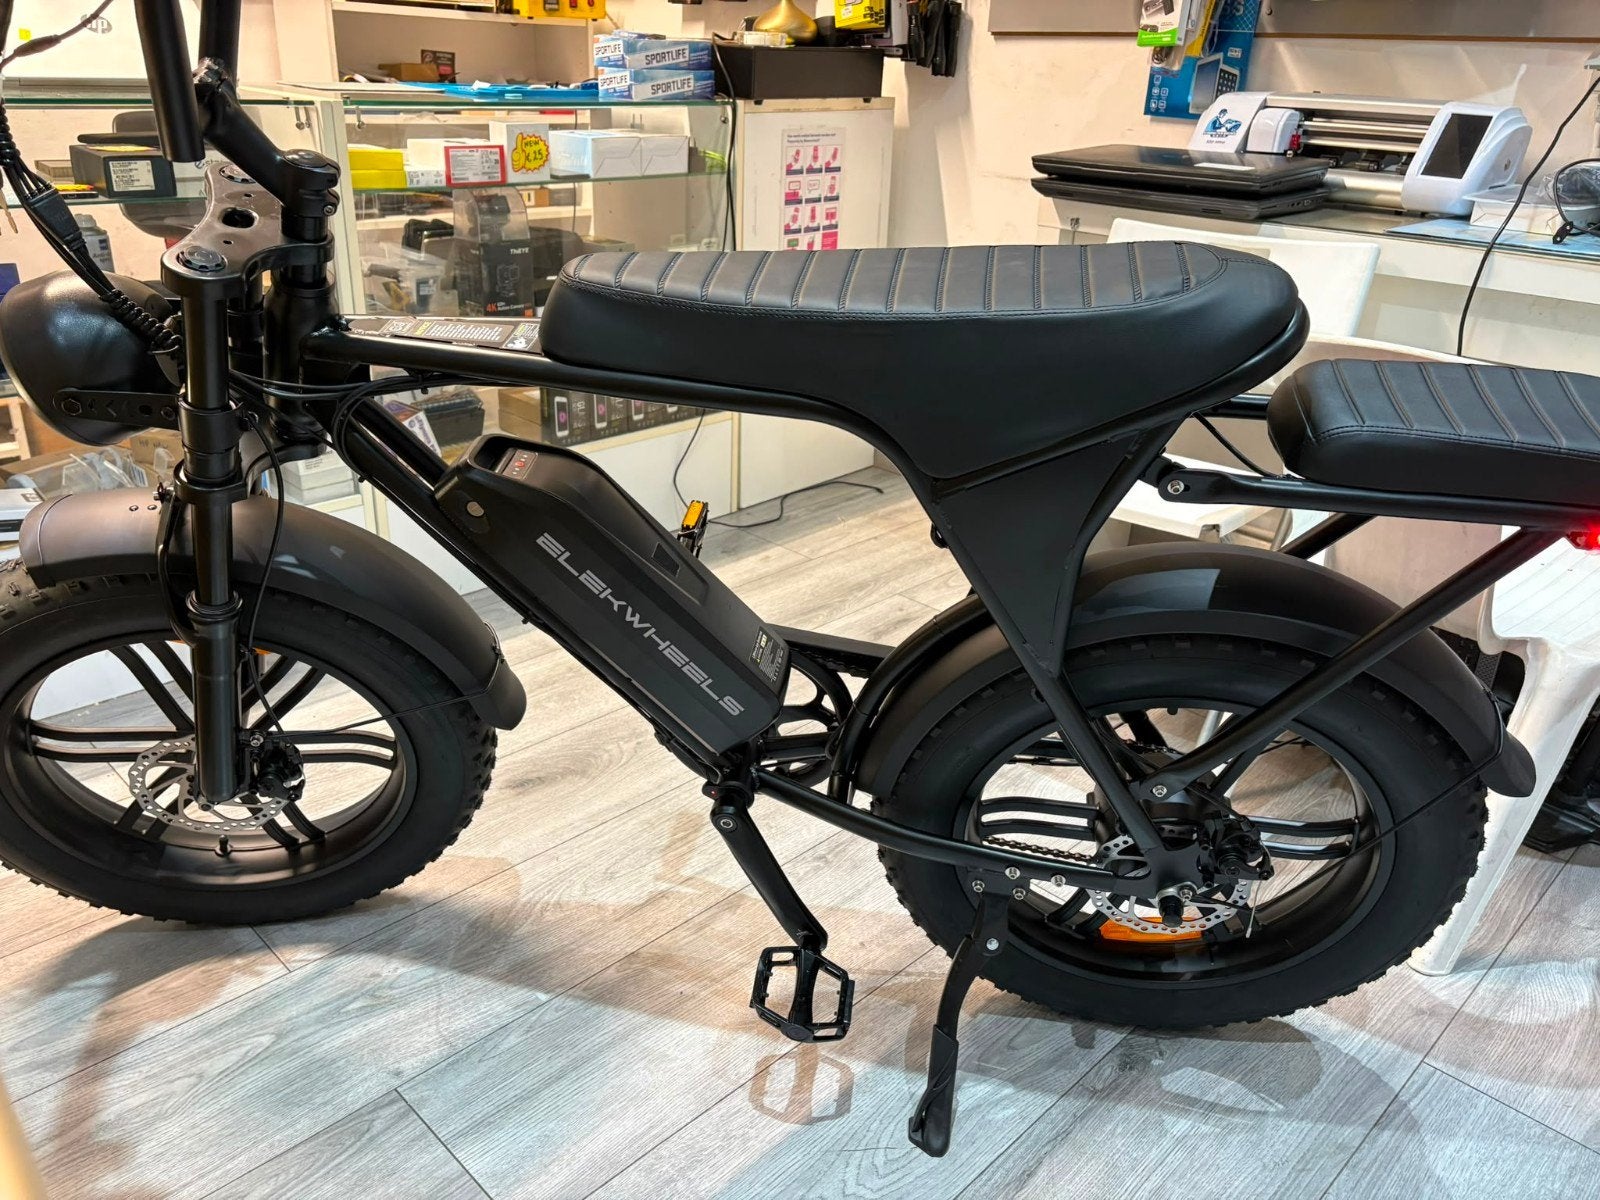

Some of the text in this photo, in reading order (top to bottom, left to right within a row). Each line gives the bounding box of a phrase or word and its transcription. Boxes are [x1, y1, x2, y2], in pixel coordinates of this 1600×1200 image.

[595, 43, 622, 56] SPORTLIFE
[645, 47, 688, 65] SPORTLIFE
[600, 74, 628, 87] SPORTLIFE
[651, 77, 692, 95] SPORTLIFE
[524, 139, 540, 148] NEW
[536, 532, 745, 716] ELEKWHEELS
